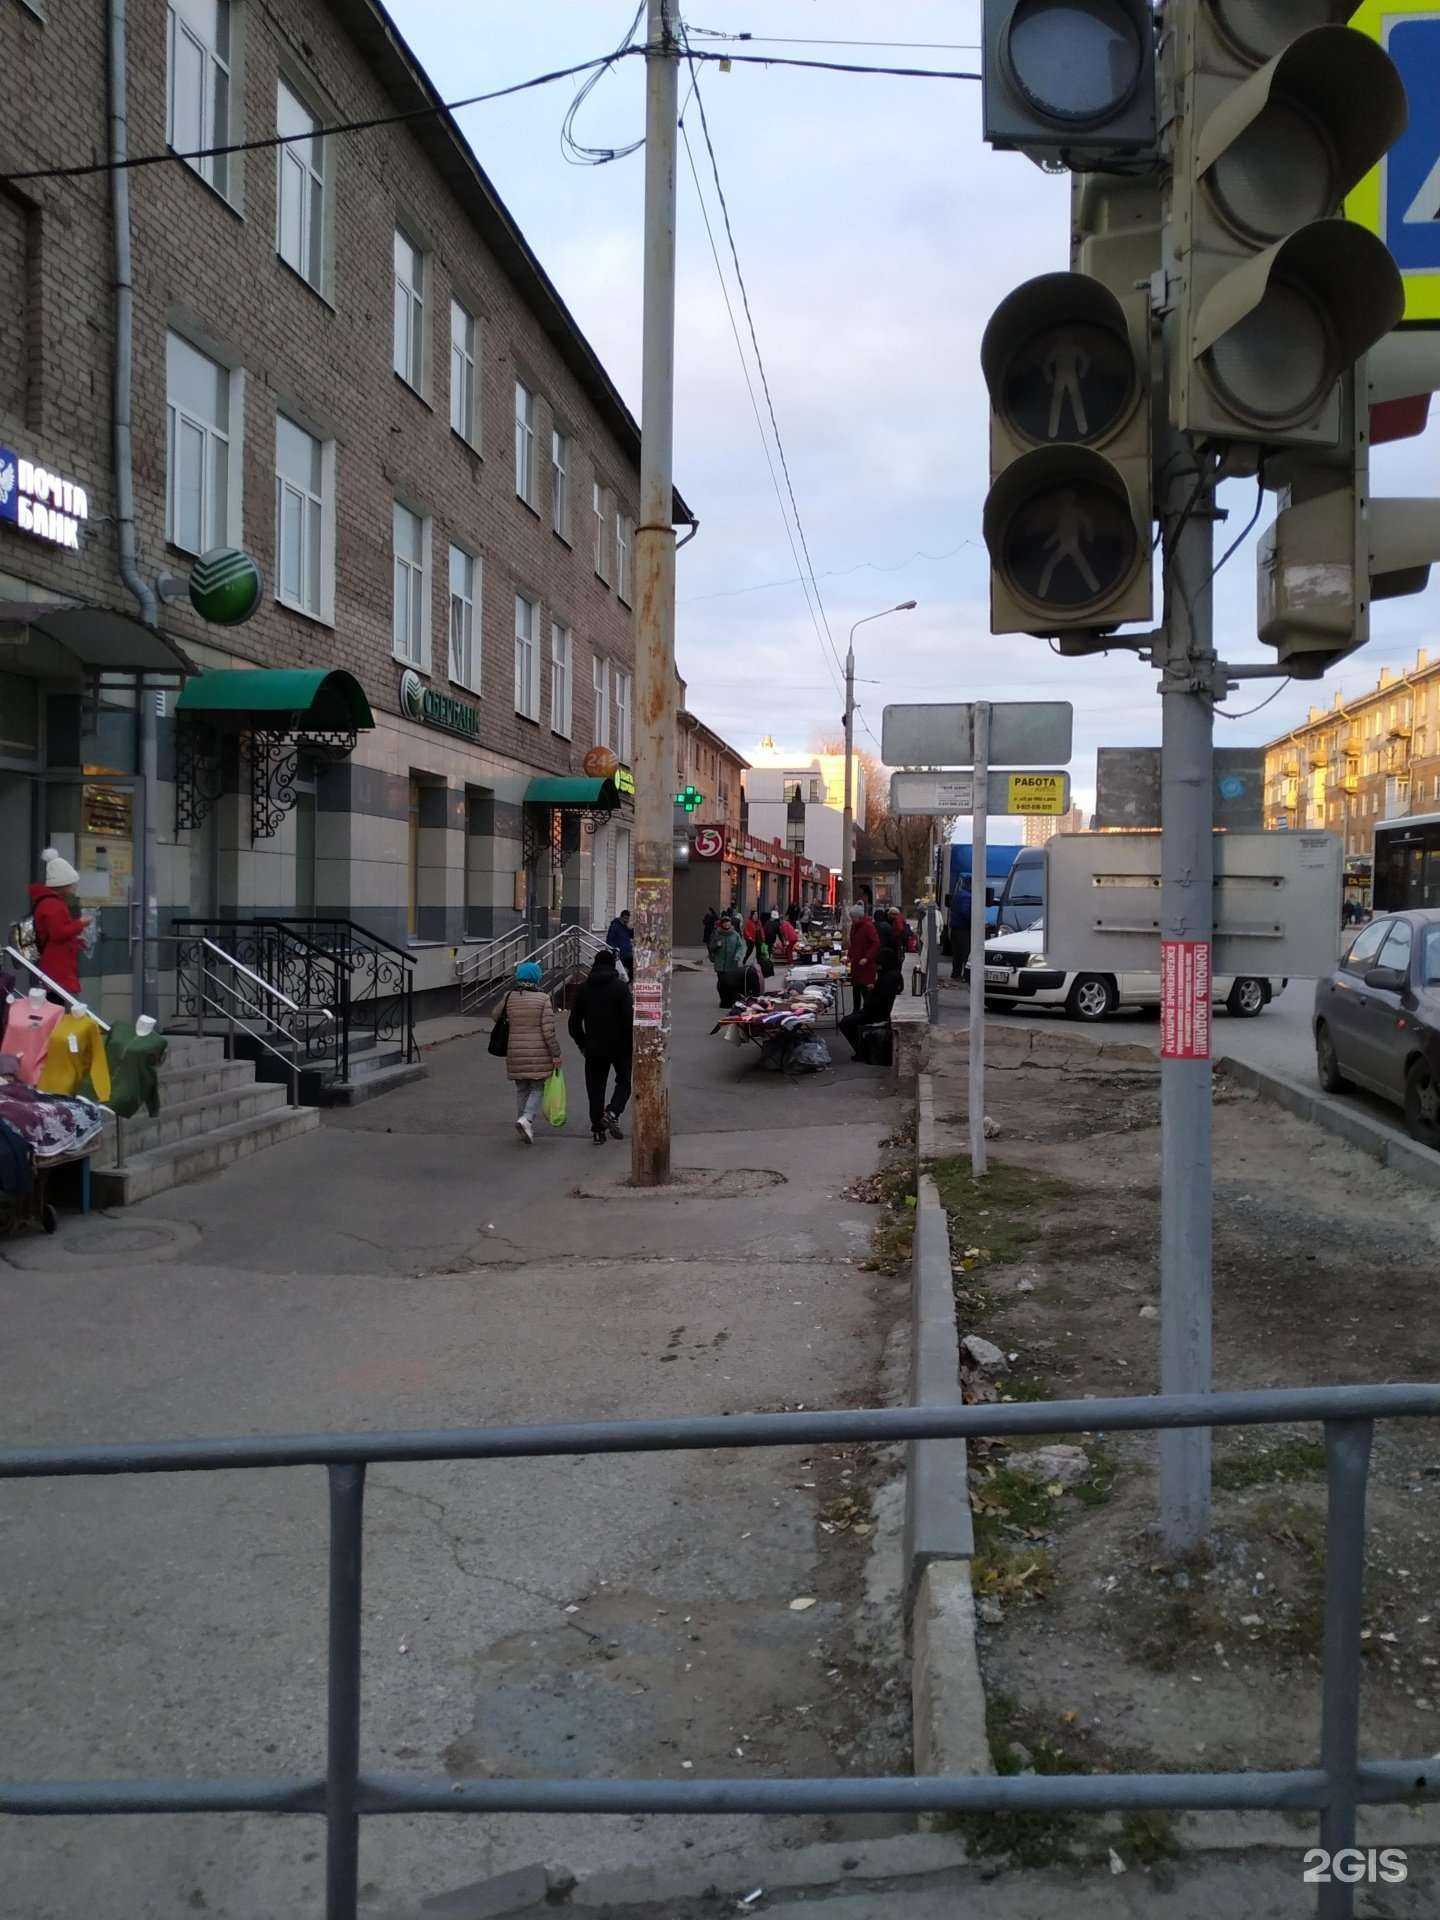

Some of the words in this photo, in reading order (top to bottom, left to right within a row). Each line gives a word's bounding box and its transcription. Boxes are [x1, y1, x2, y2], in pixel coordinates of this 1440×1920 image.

[18, 496, 79, 550] БАНК
[424, 688, 480, 734] СБЕРБАНК
[1014, 777, 1056, 787] РАБОТА
[1195, 944, 1208, 998] ПОМОЩЬ
